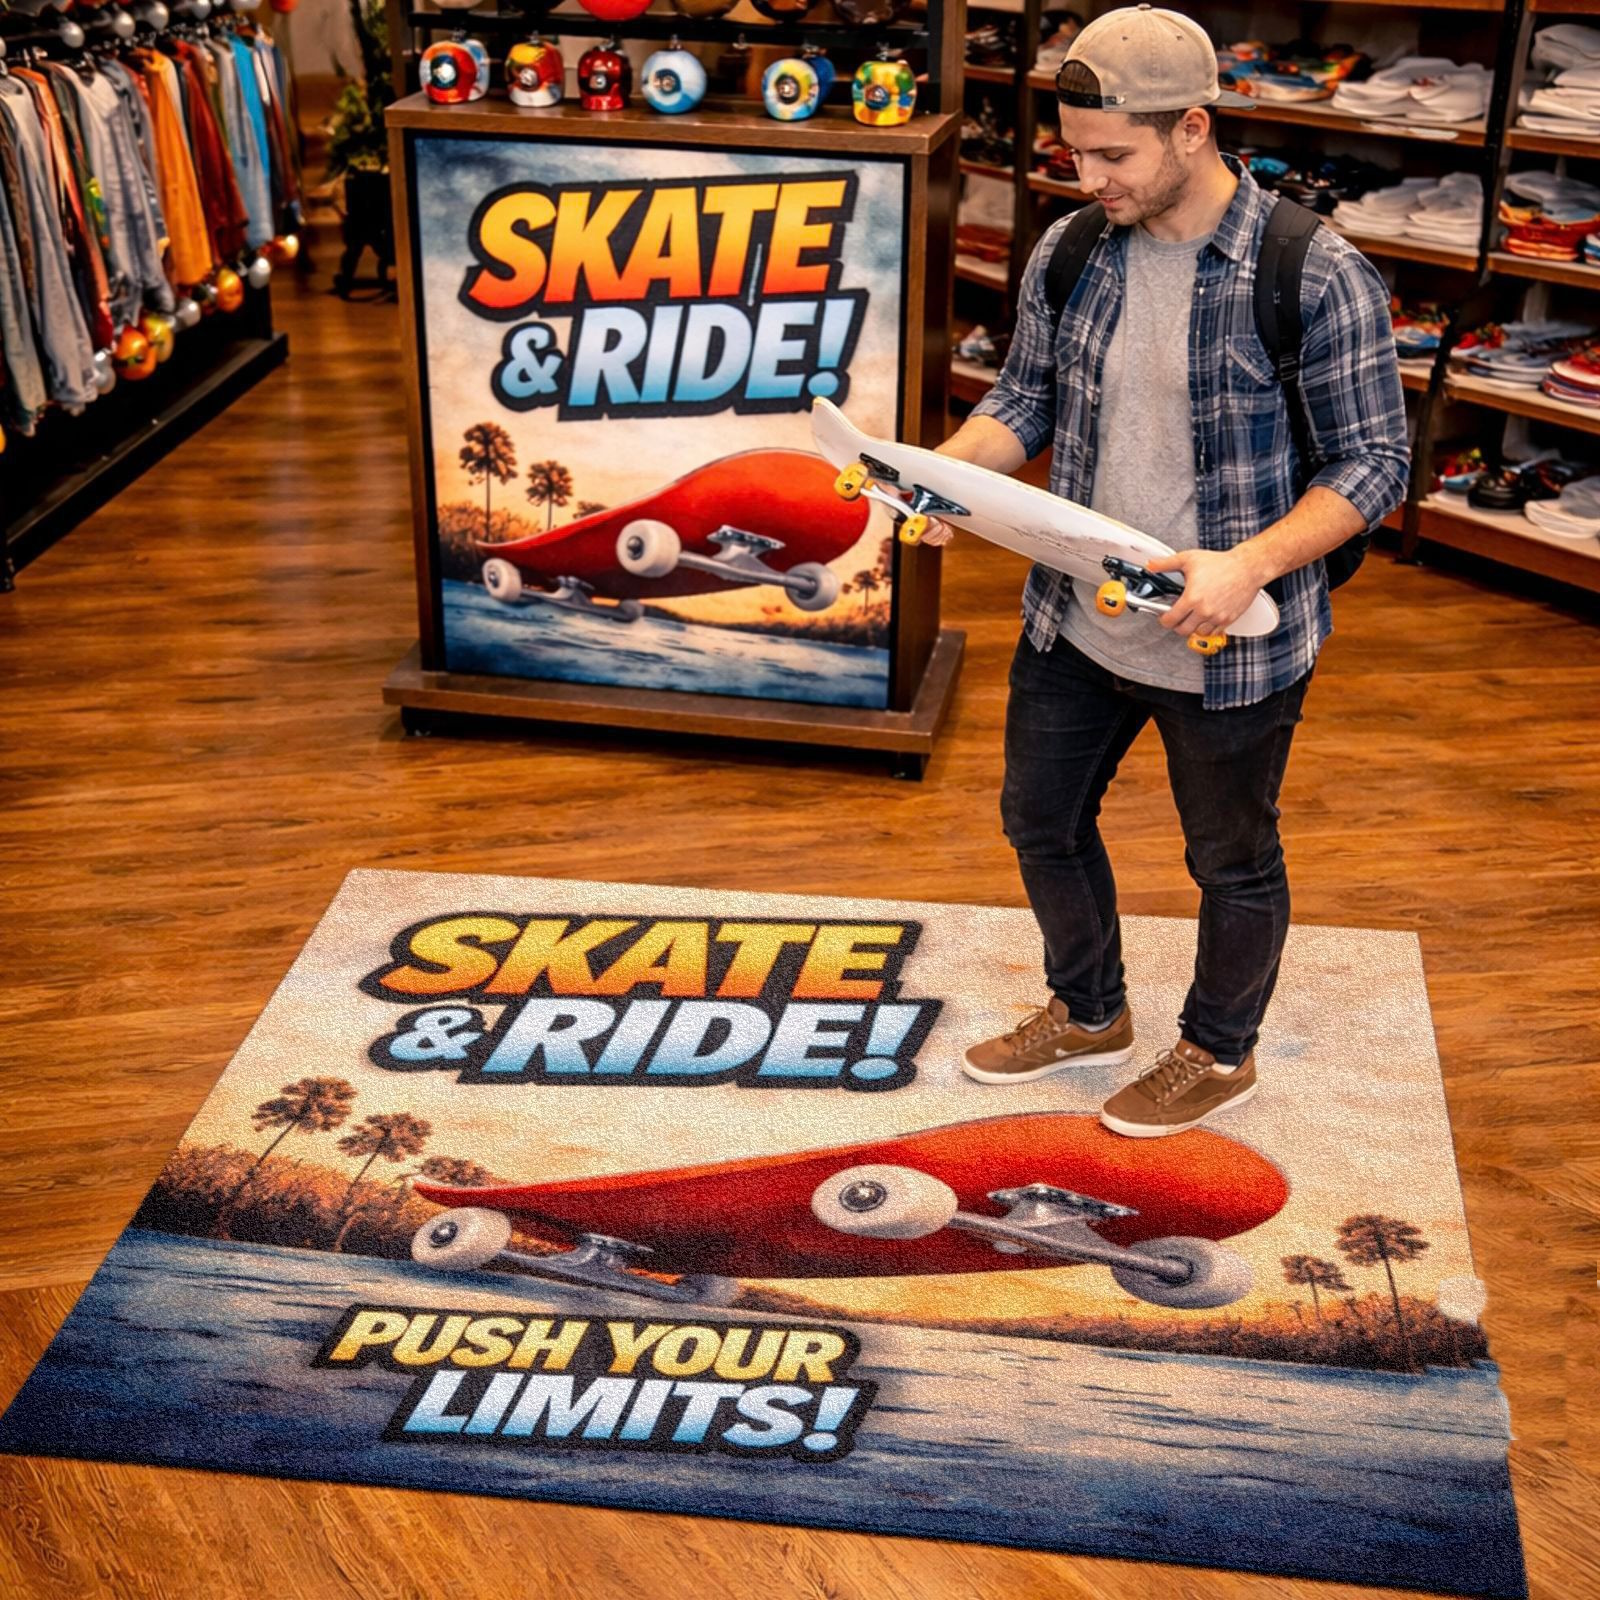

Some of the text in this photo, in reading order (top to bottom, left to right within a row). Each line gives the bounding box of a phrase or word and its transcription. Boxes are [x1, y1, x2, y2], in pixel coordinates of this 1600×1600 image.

[468, 179, 848, 309] SKATE
[500, 298, 855, 406] & RIDE!
[379, 917, 905, 1000] SKATE
[388, 998, 922, 1081] & RIDE!
[329, 1311, 847, 1383] PUSH YOUR
[403, 1370, 861, 1452] LIMITS!
